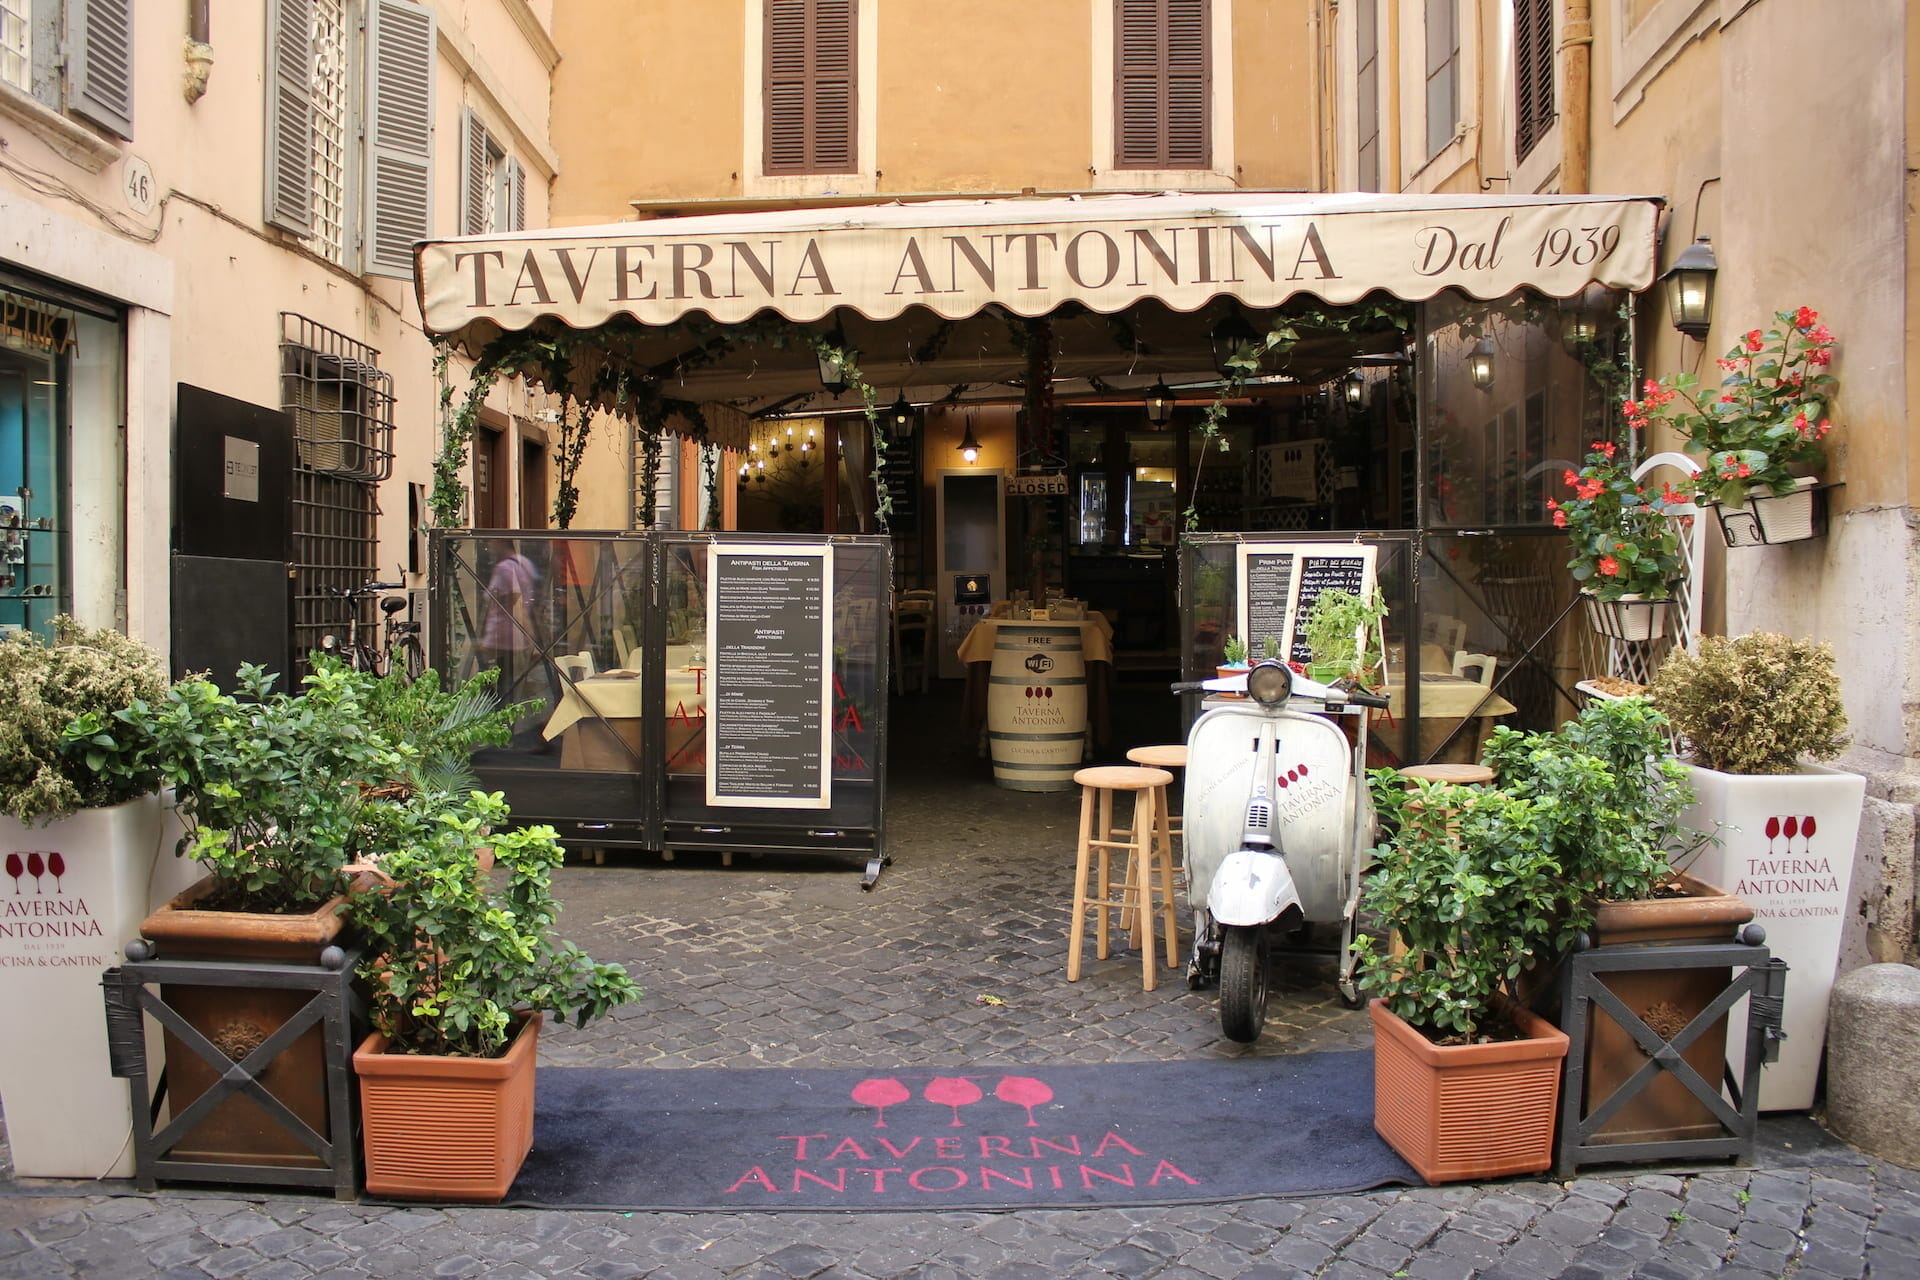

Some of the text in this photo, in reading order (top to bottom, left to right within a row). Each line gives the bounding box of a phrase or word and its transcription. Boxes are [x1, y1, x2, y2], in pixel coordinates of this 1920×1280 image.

[129, 169, 148, 204] 46
[454, 215, 1621, 308] TAVERNA ANTONINA Dal 1939
[1007, 483, 1066, 494] CLOSED
[1028, 636, 1051, 644] FREE
[1012, 716, 1066, 725] ANTONINA
[1016, 706, 1062, 716] TAVERNA
[1280, 779, 1331, 812] TAVERNA
[1282, 786, 1342, 827] ANTONINA
[1747, 857, 1832, 876] TAVERNA
[1736, 876, 1839, 895] ANTONINA
[1778, 908, 1787, 918] &
[1790, 906, 1839, 918] CANTINA
[0, 956, 34, 967] CINA
[38, 956, 48, 967] &
[776, 1131, 1150, 1161] TAVERNA
[724, 1158, 1202, 1194] ANTONINA
